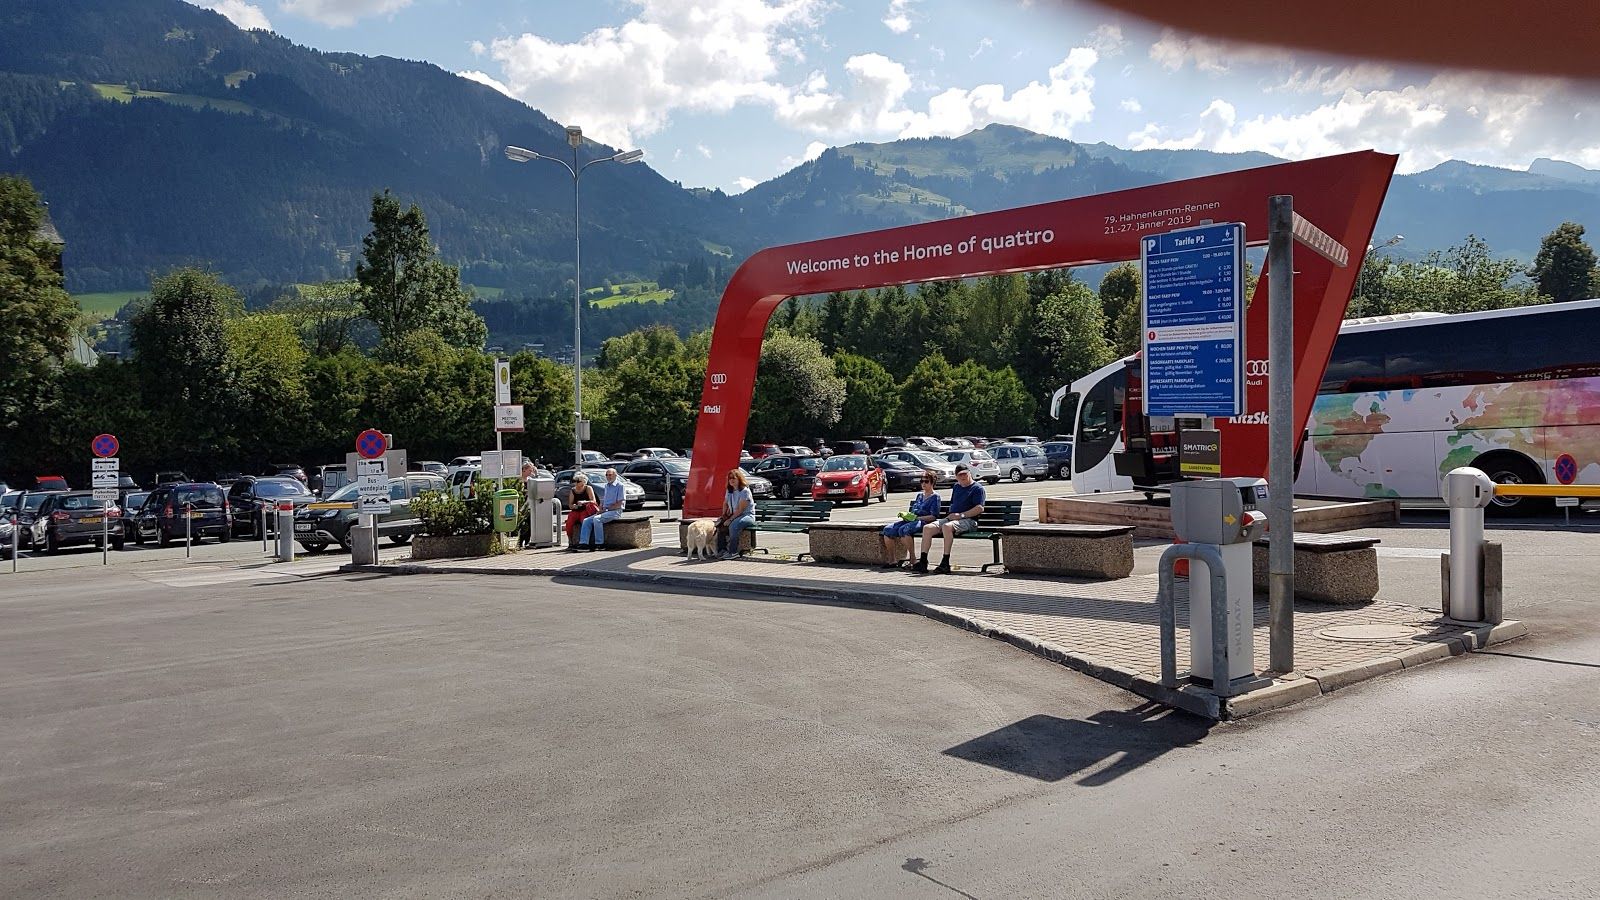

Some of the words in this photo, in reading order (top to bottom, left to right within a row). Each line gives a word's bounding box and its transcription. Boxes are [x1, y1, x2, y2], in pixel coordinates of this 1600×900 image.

[1104, 216, 1118, 224] 79.
[1119, 202, 1220, 222] Hahnenkamm-Rennen
[1104, 224, 1134, 234] 21.-27.
[1136, 220, 1165, 231] Jänner
[1168, 215, 1192, 226] 2019
[786, 258, 850, 274] Welcome
[854, 254, 869, 267] to
[874, 249, 899, 264] the
[904, 245, 952, 260] Home
[958, 236, 976, 253] of
[981, 229, 1054, 254] quattro
[1148, 239, 1156, 251] P
[1175, 236, 1194, 246] Tarife
[1196, 235, 1204, 244] P2
